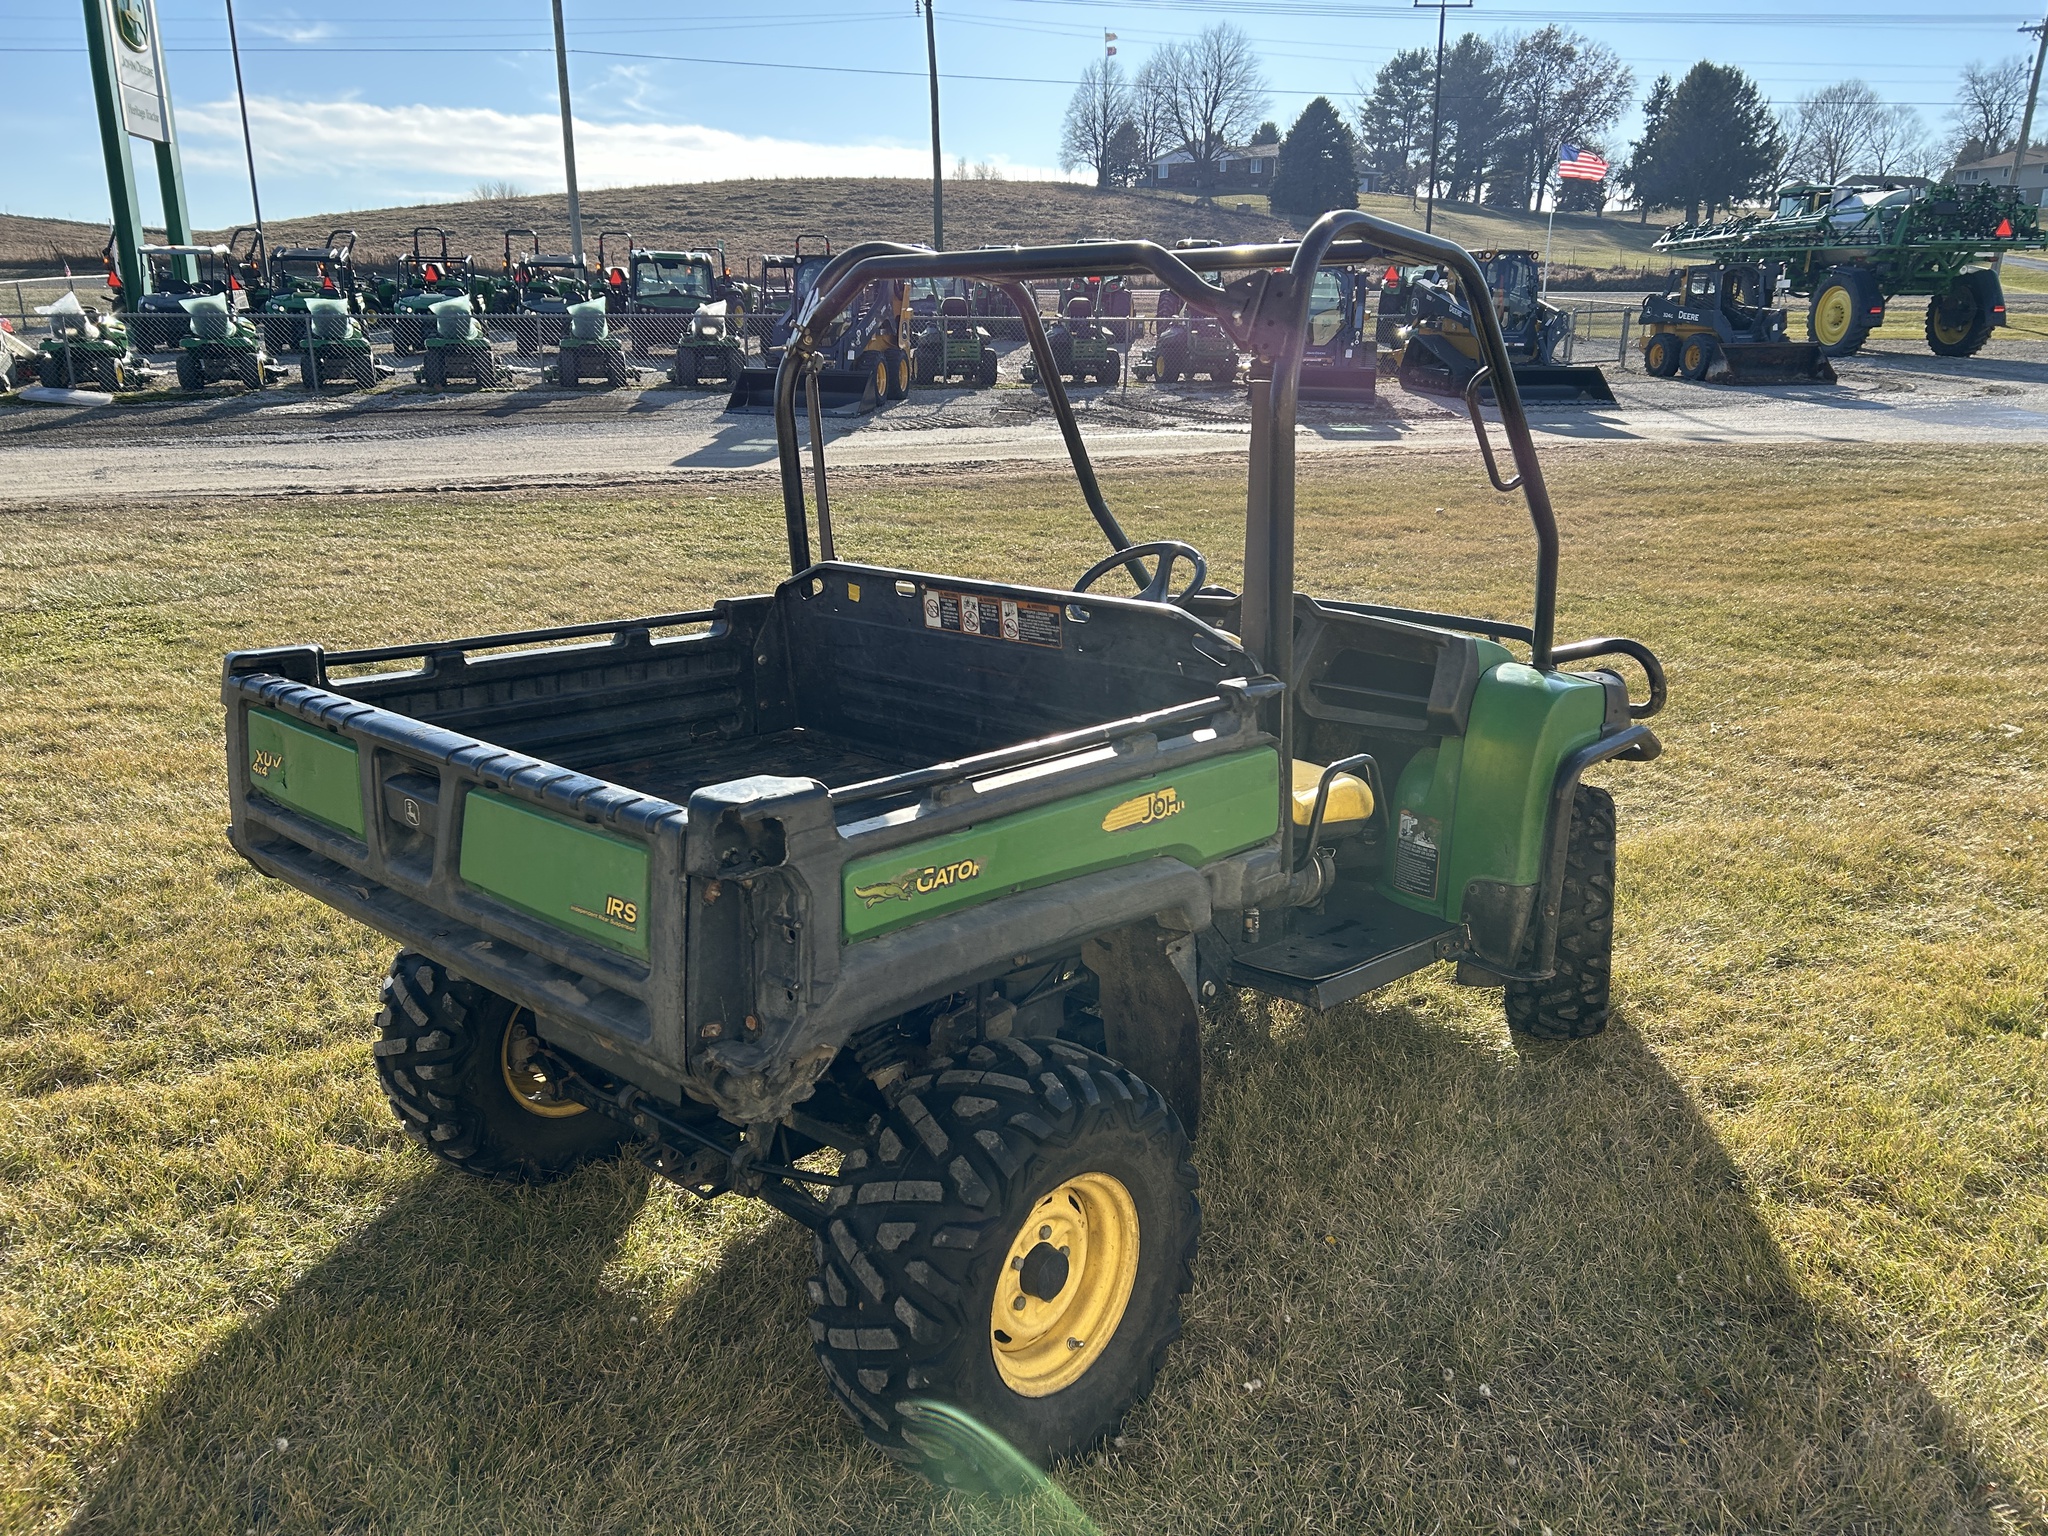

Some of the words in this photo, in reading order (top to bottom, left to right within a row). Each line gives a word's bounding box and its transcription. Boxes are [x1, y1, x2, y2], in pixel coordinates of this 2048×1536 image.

[121, 55, 137, 71] JOHN
[136, 61, 155, 78] DEERE
[1678, 310, 1700, 322] DEERE
[254, 749, 283, 768] XUV
[1142, 795, 1185, 823] JOH
[606, 896, 638, 924] IRS
